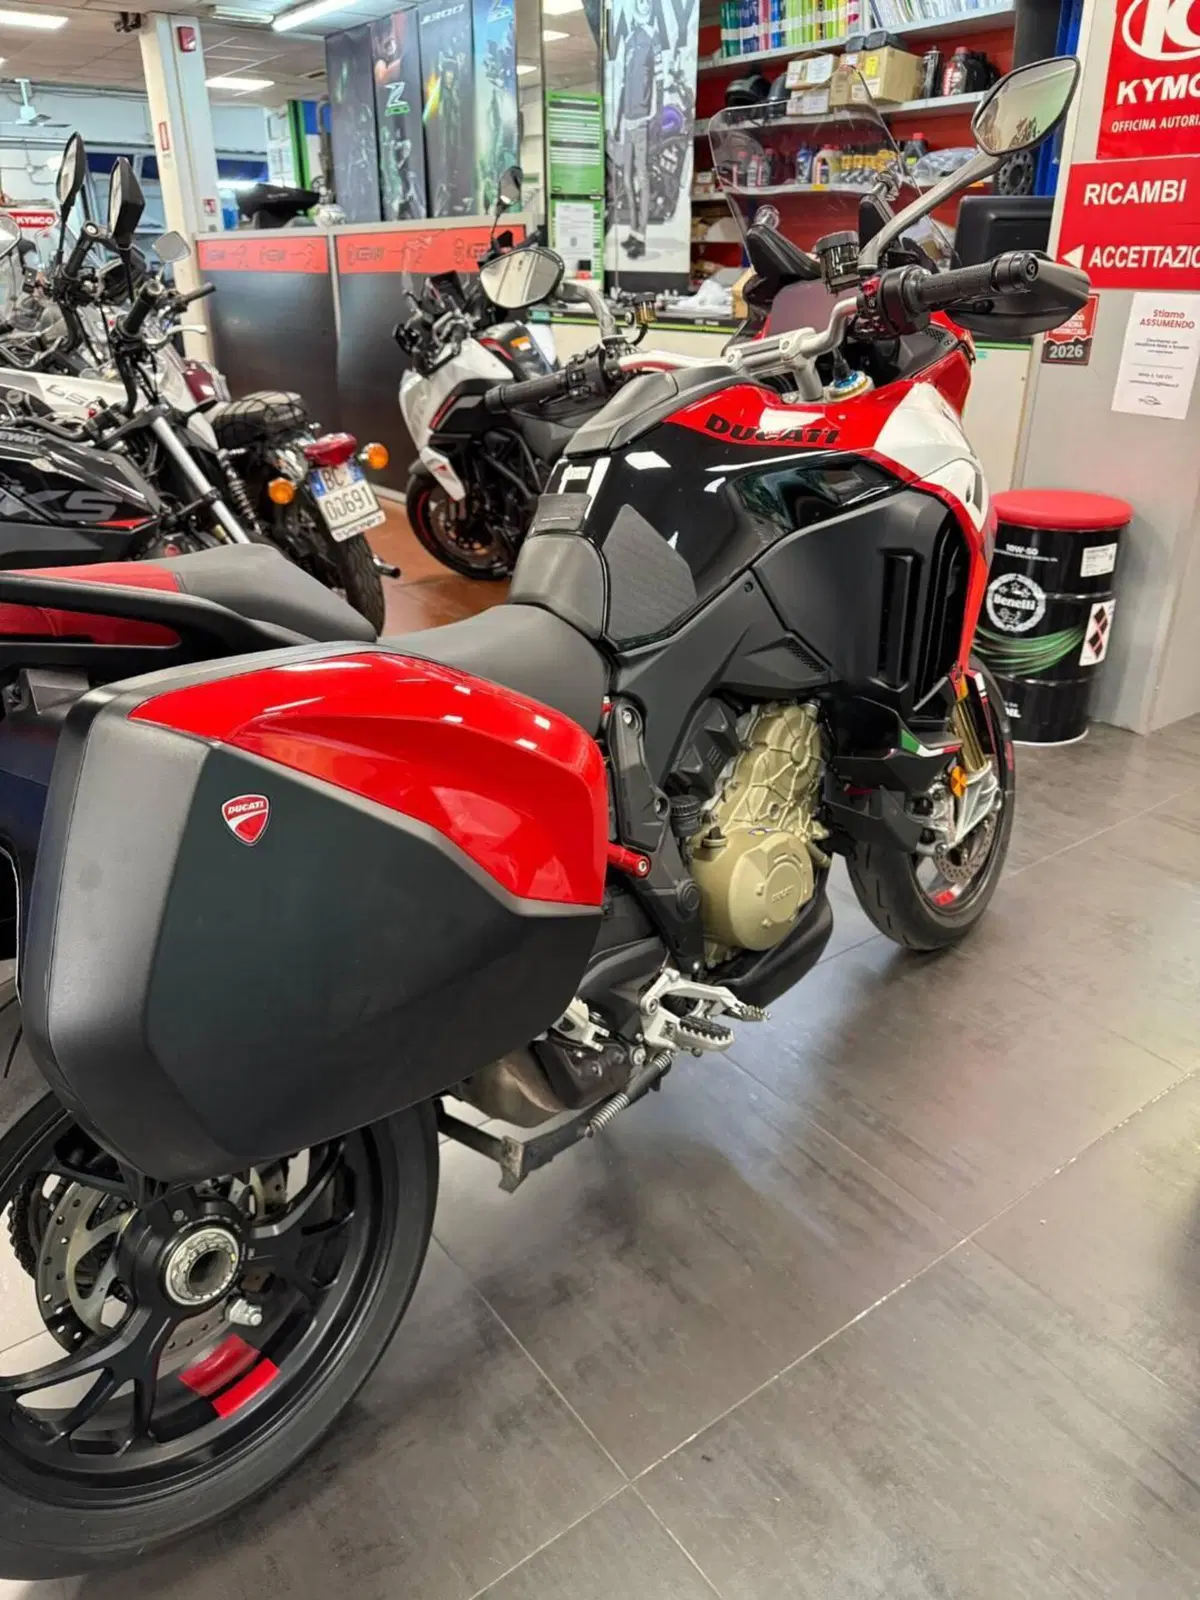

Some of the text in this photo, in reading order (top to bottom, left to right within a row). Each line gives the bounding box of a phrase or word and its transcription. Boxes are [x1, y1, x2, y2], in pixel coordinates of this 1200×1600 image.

[1111, 118, 1157, 133] OFFICINA
[1083, 178, 1187, 206] RICAMBI
[1152, 308, 1185, 319] Stiamo
[1139, 318, 1196, 330] ASSUMENDO
[1048, 343, 1085, 359] 2026
[704, 412, 840, 445] DUCATI
[993, 593, 1036, 611] Benelli
[227, 800, 265, 815] DUCATI
